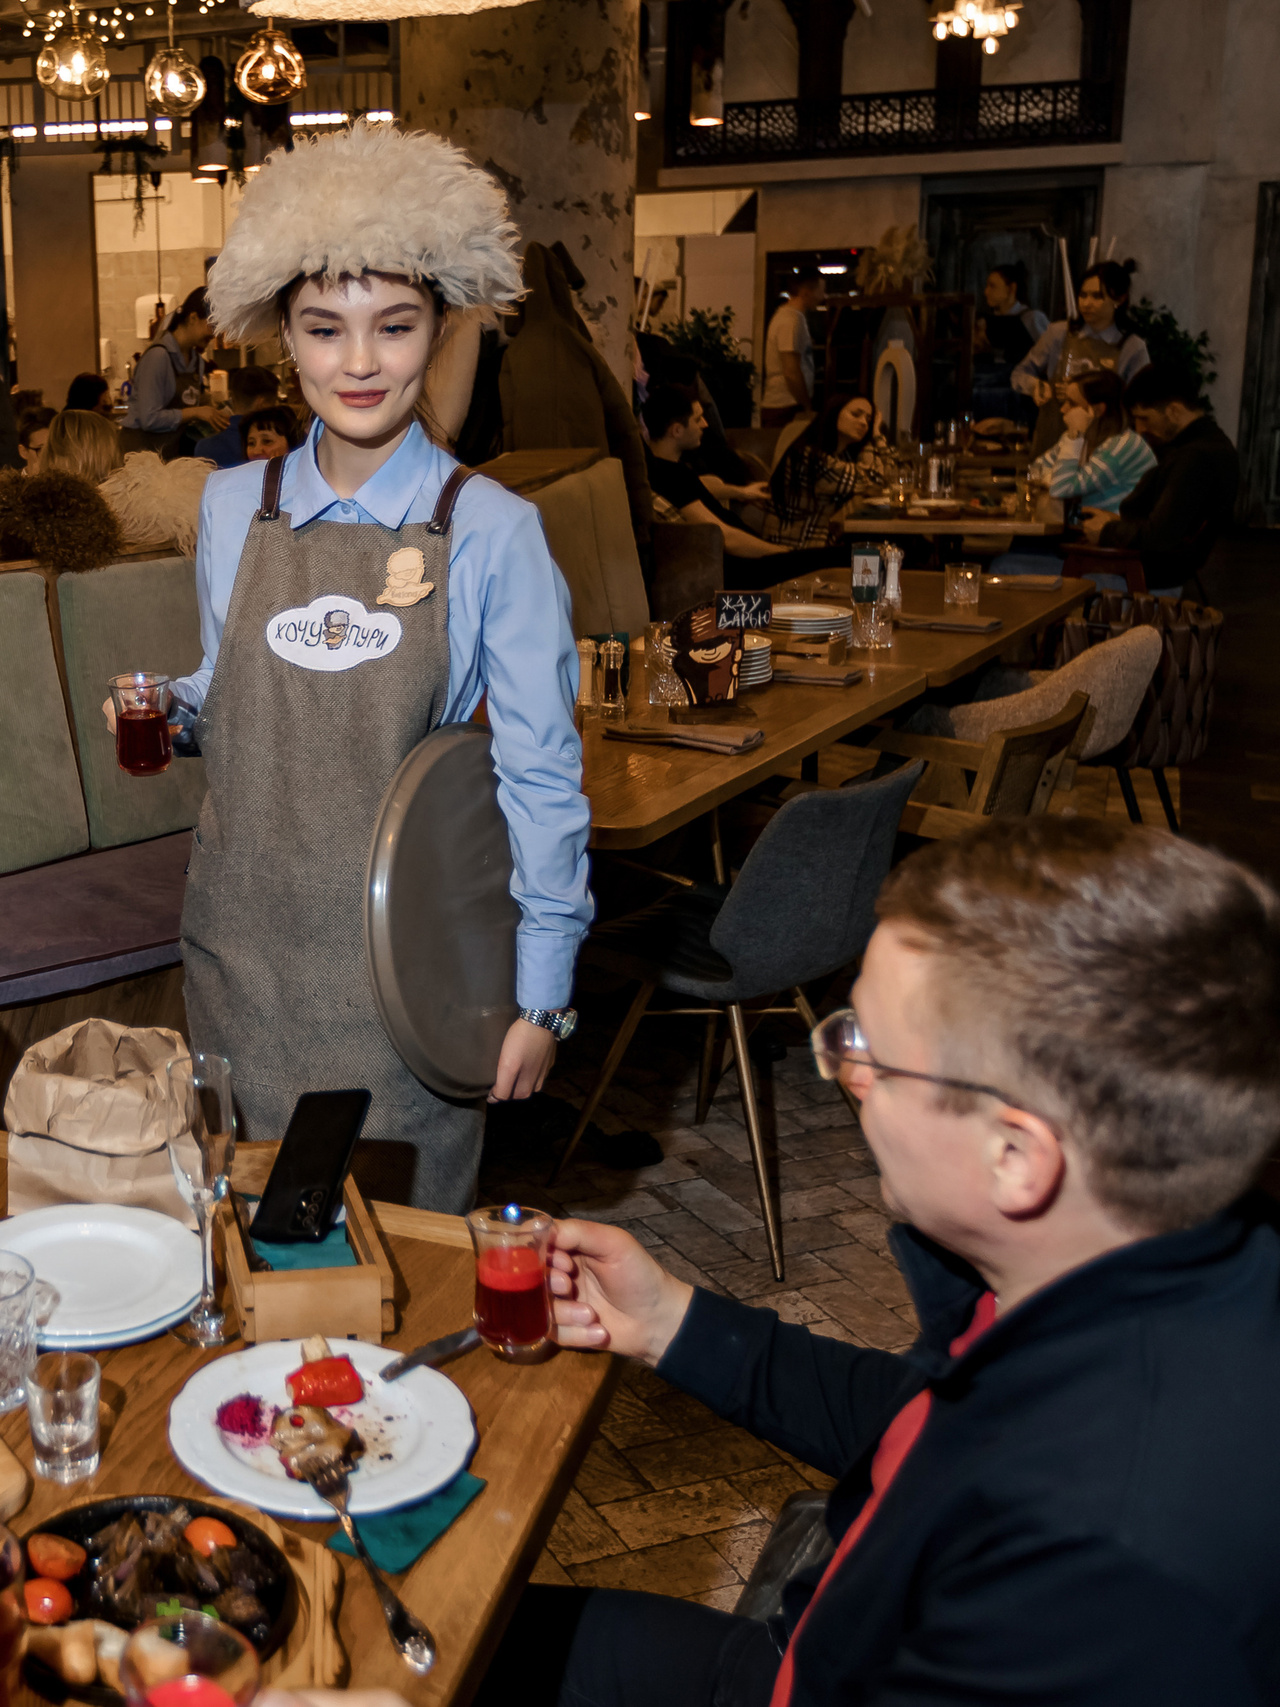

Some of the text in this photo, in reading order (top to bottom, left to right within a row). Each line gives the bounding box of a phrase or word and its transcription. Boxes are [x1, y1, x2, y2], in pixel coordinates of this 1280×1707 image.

[721, 595, 762, 613] ЖДУ
[717, 609, 771, 630] ДАРЬЮ
[275, 619, 390, 651] ХОЧУ ПУРИ
